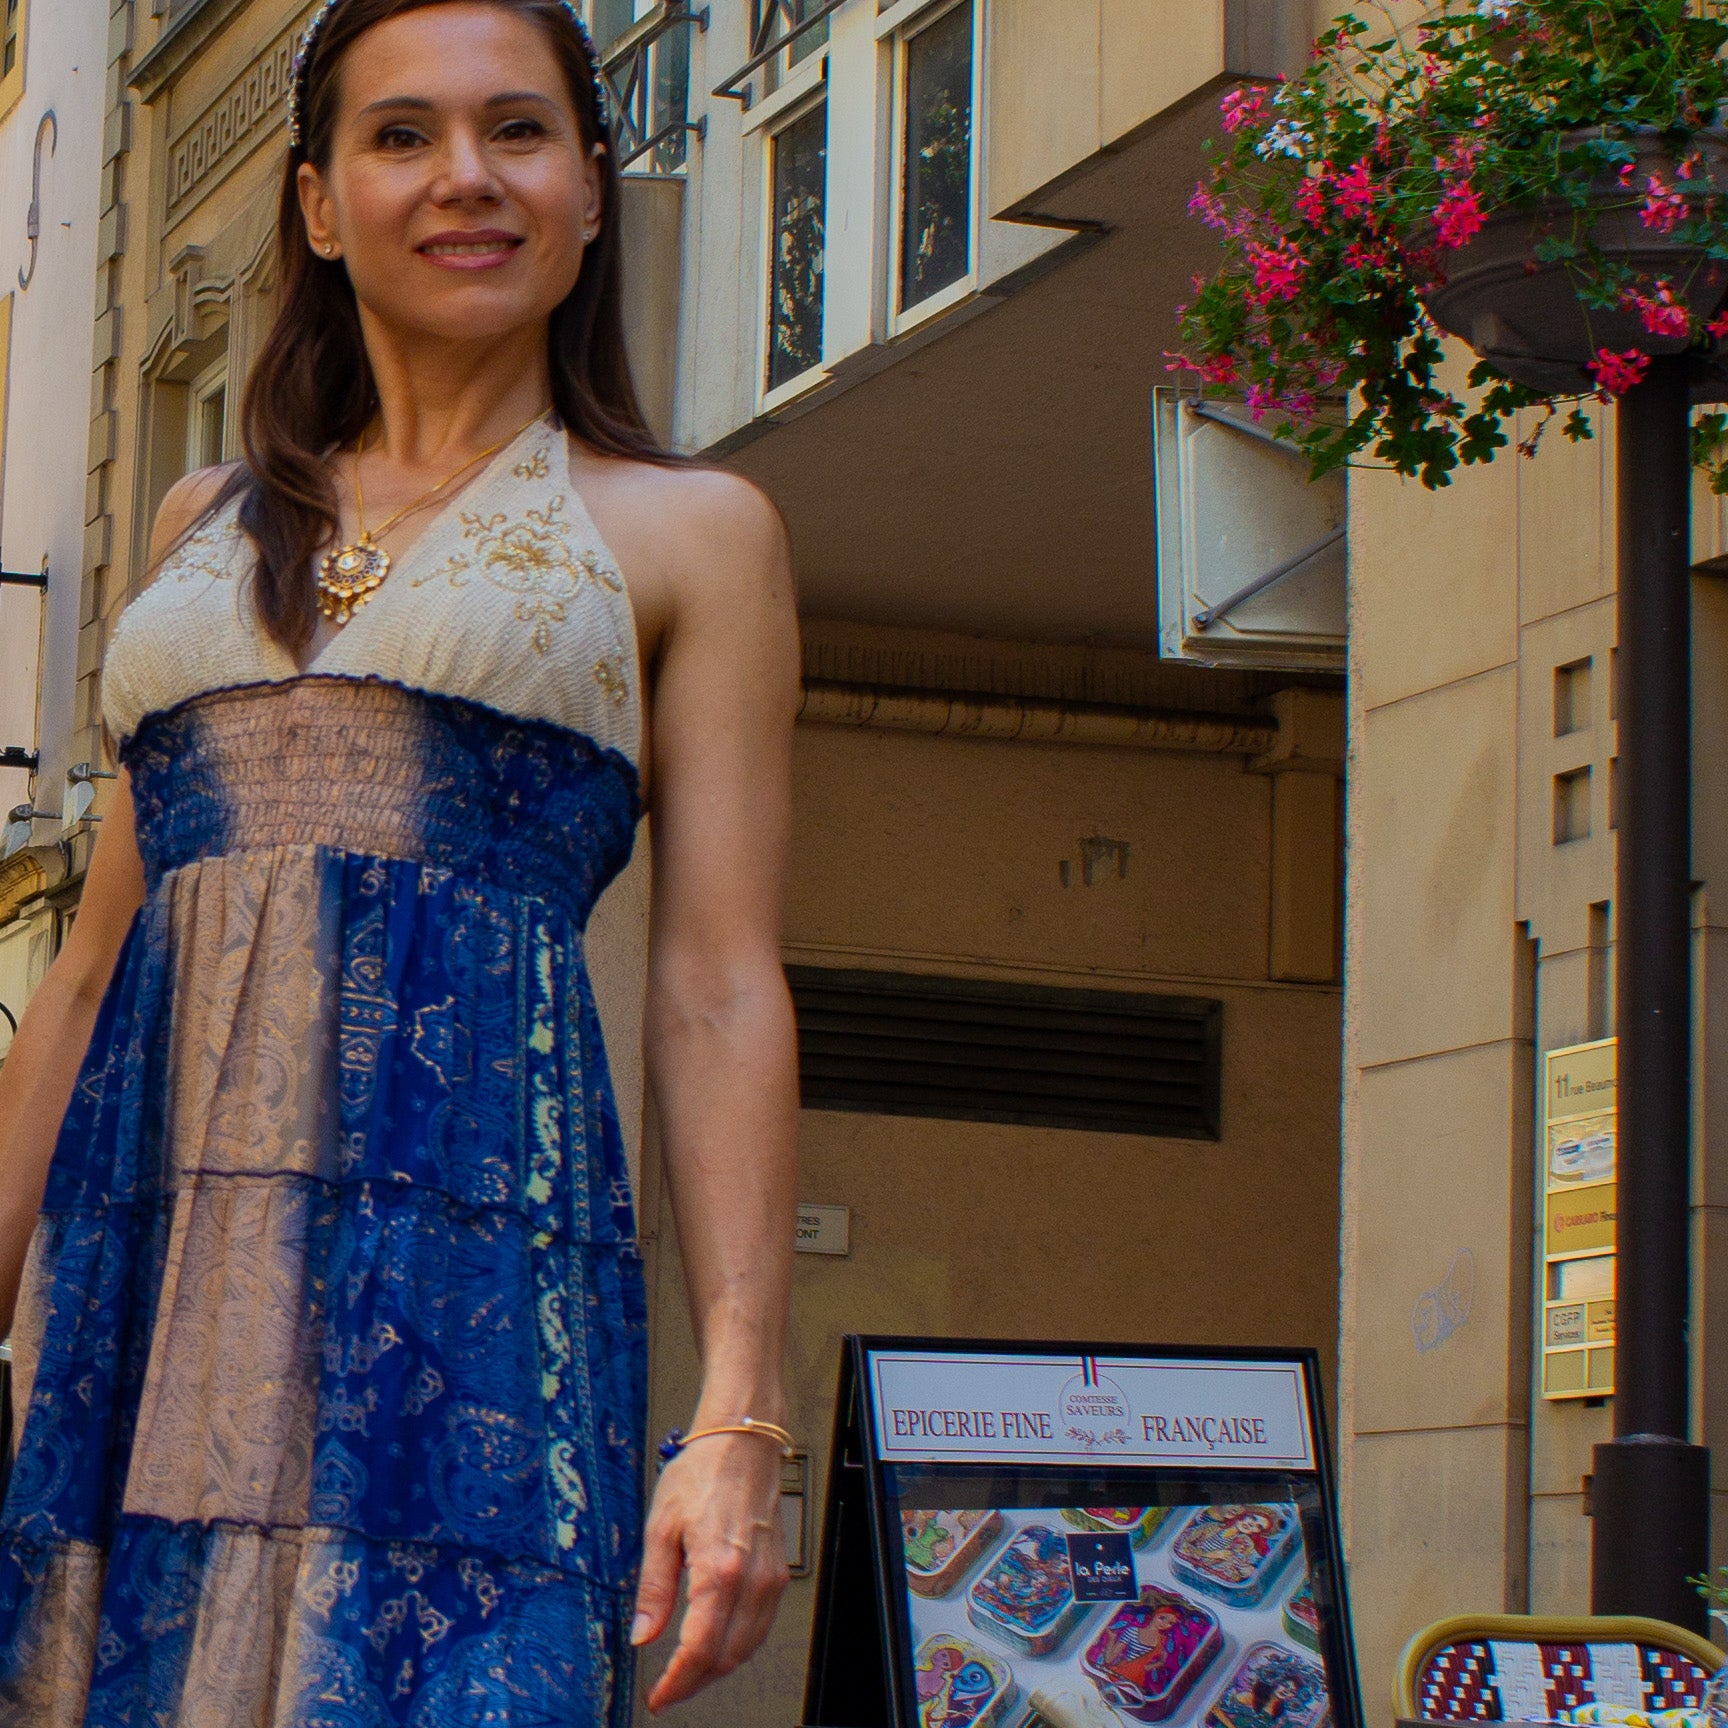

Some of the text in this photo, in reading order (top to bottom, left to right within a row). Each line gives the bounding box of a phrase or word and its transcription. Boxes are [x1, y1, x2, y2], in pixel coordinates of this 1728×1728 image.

[797, 1215, 821, 1226] TRES
[795, 1228, 820, 1240] ONT
[1069, 1394, 1118, 1405] COMTESSE
[1066, 1404, 1124, 1417] SAVEURS
[890, 1408, 1268, 1451] EPICERIE FINE FRANÇAISE
